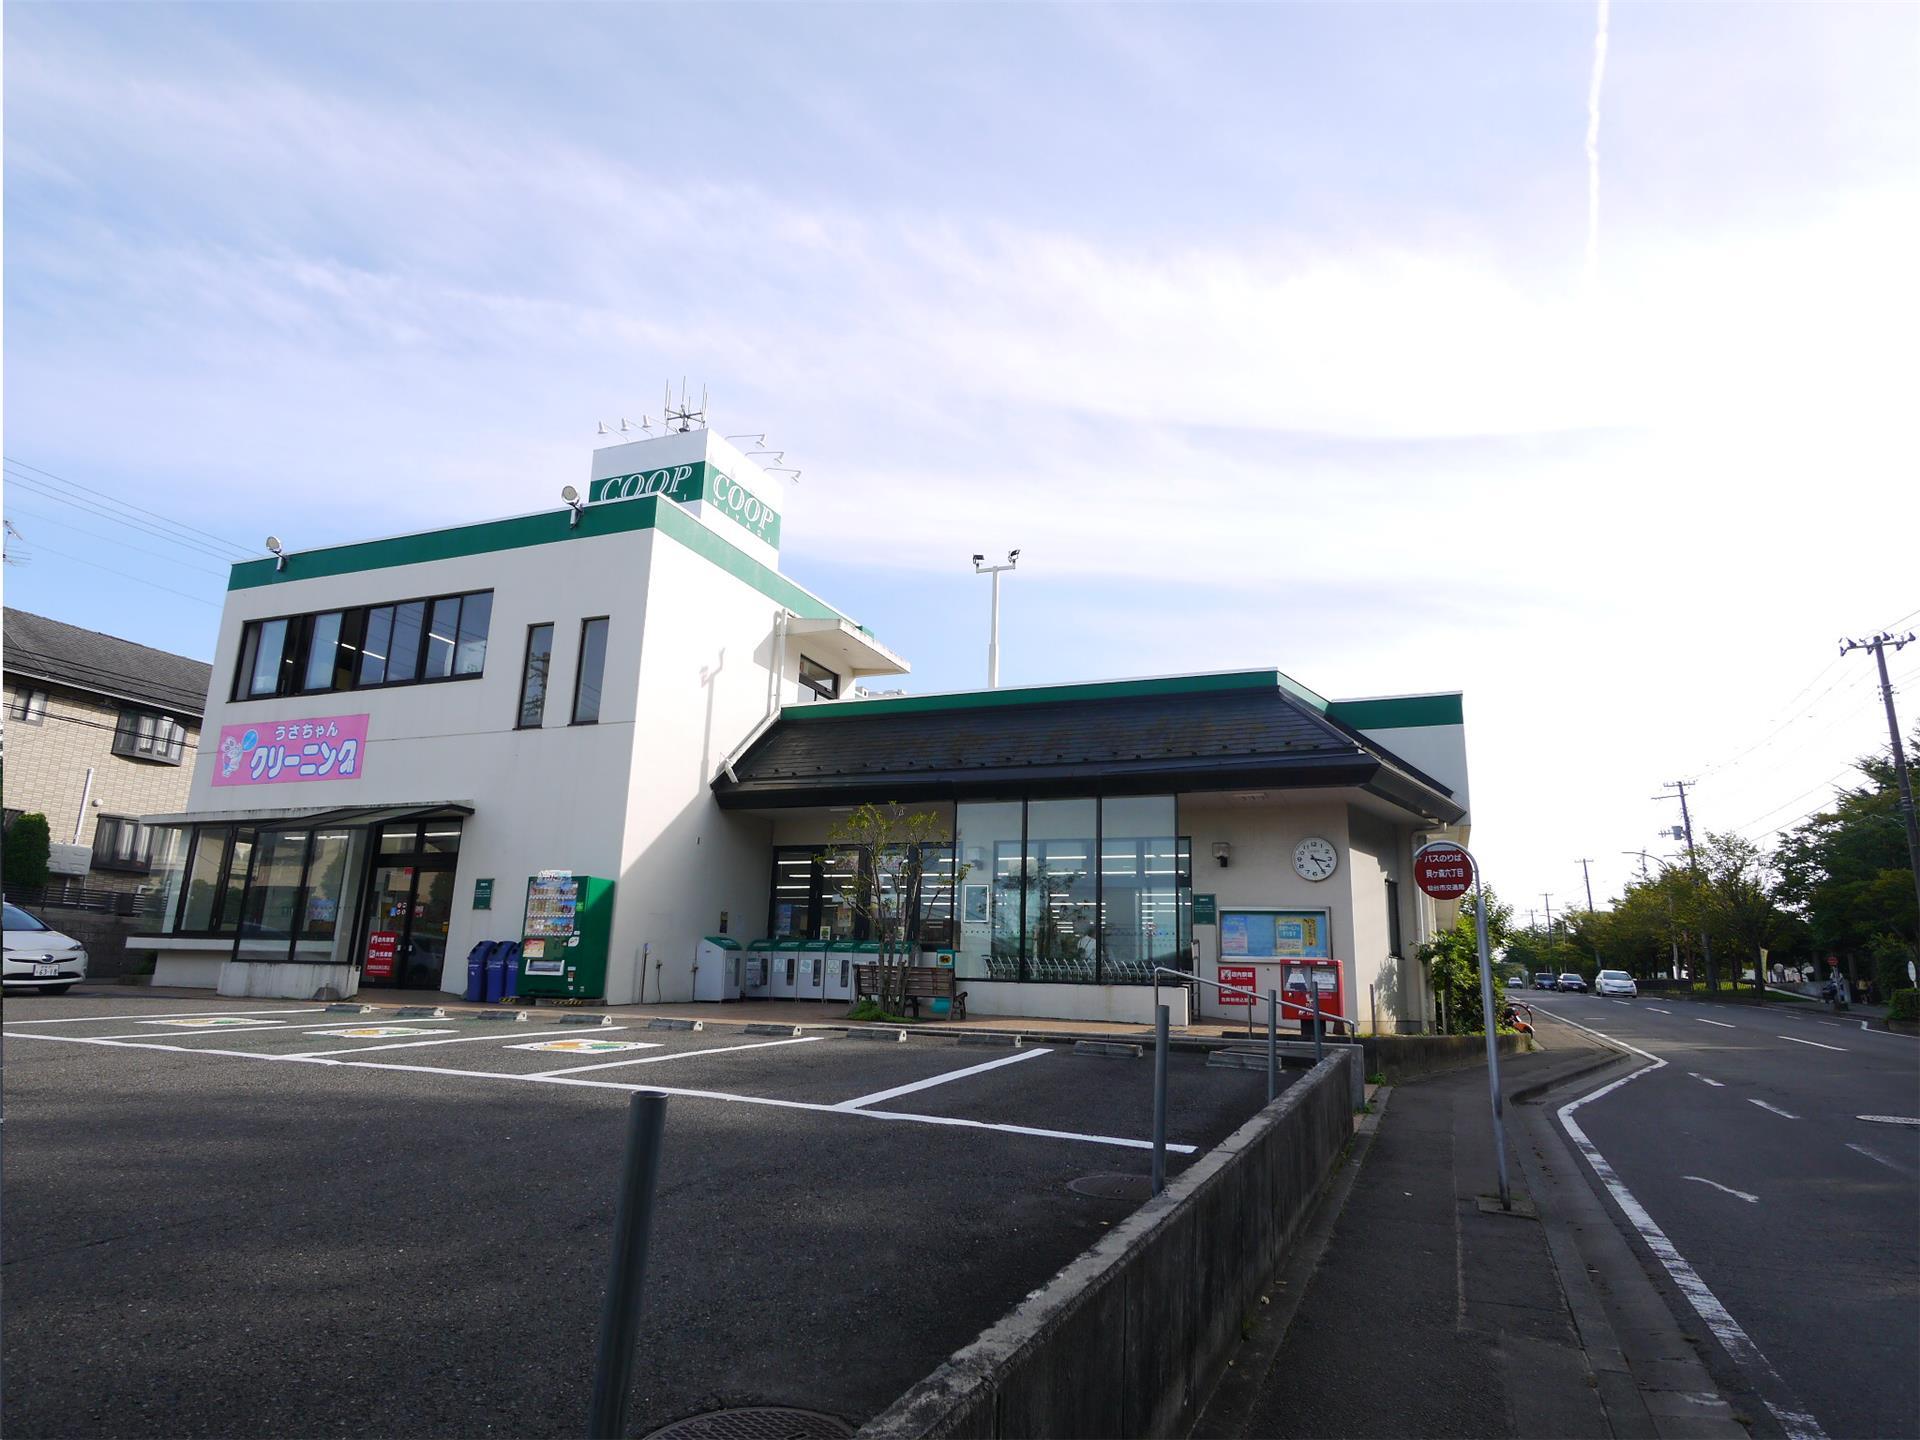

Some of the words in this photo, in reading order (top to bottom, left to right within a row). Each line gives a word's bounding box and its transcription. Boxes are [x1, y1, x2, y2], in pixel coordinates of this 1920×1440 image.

[600, 466, 692, 501] COOP
[714, 474, 774, 530] COOP
[275, 722, 338, 740] うさちゃん
[250, 738, 358, 780] クリーニング
[1425, 854, 1463, 863] バスのりば
